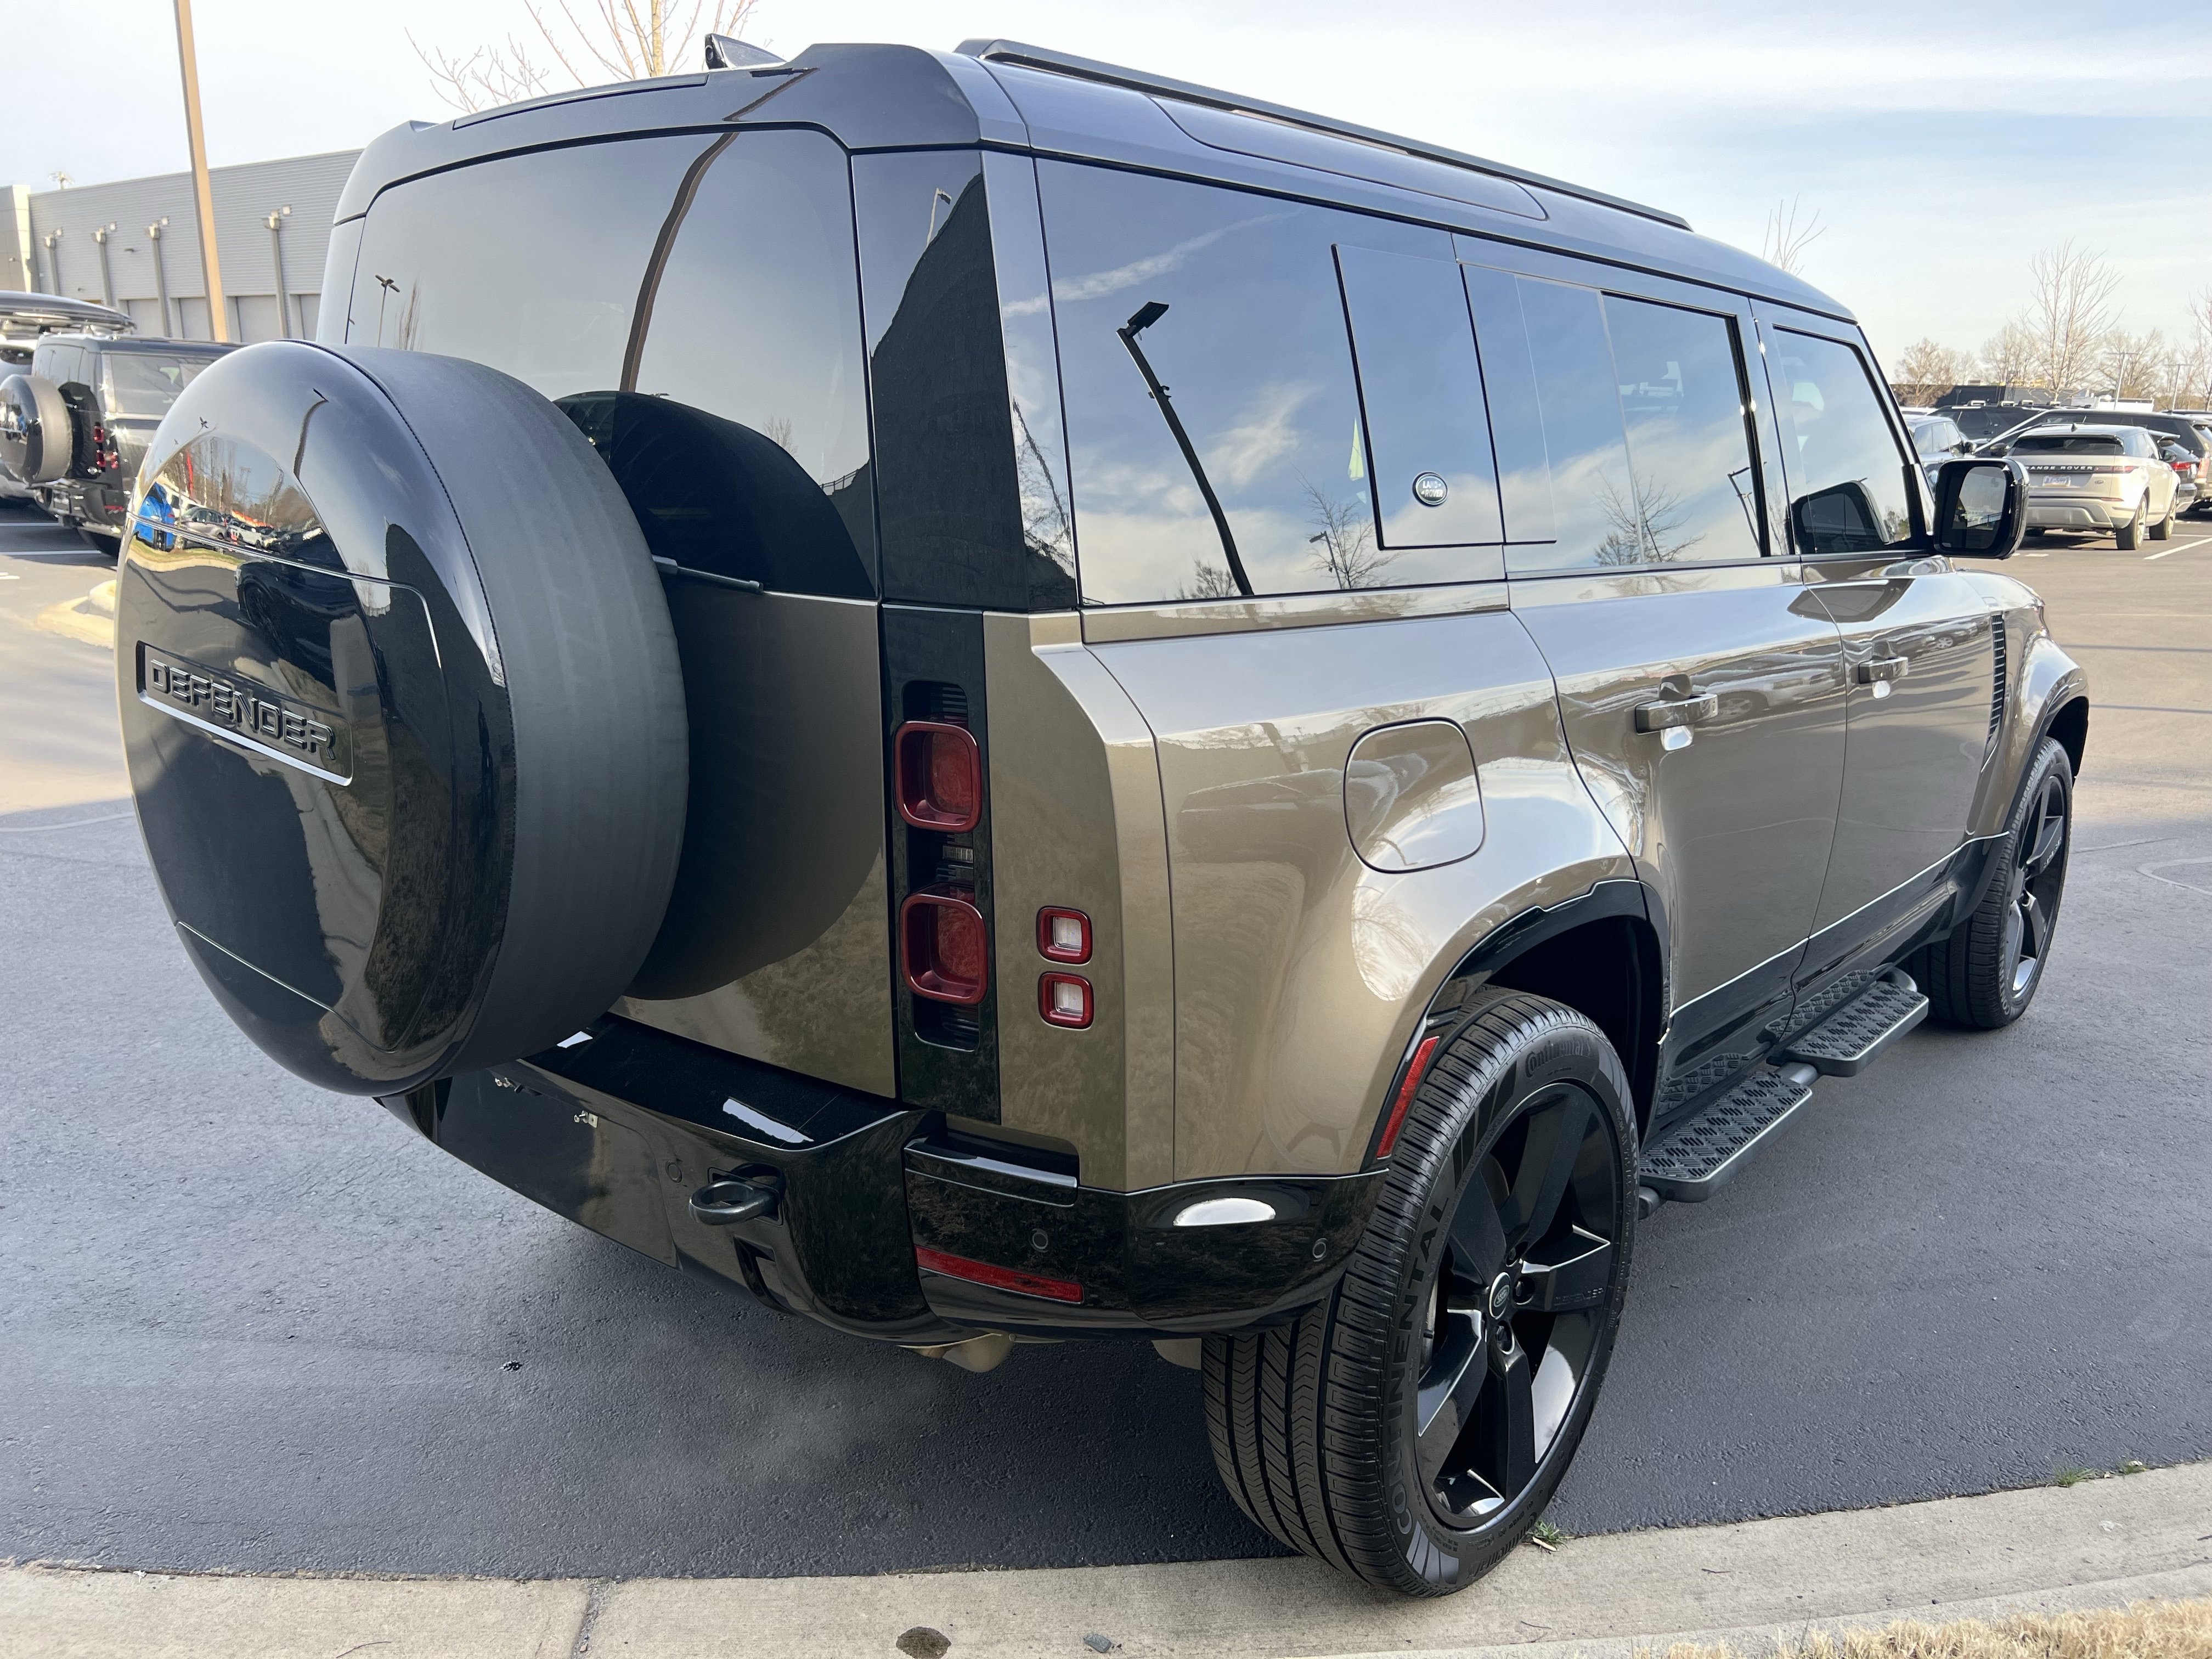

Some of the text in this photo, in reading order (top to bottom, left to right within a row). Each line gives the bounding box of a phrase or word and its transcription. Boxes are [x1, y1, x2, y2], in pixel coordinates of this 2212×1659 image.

[1423, 481, 1438, 489] LAND
[1425, 489, 1443, 498] ROVER
[150, 659, 336, 760] DEFENDER
[1386, 1197, 1449, 1535] CONTINENTAL
